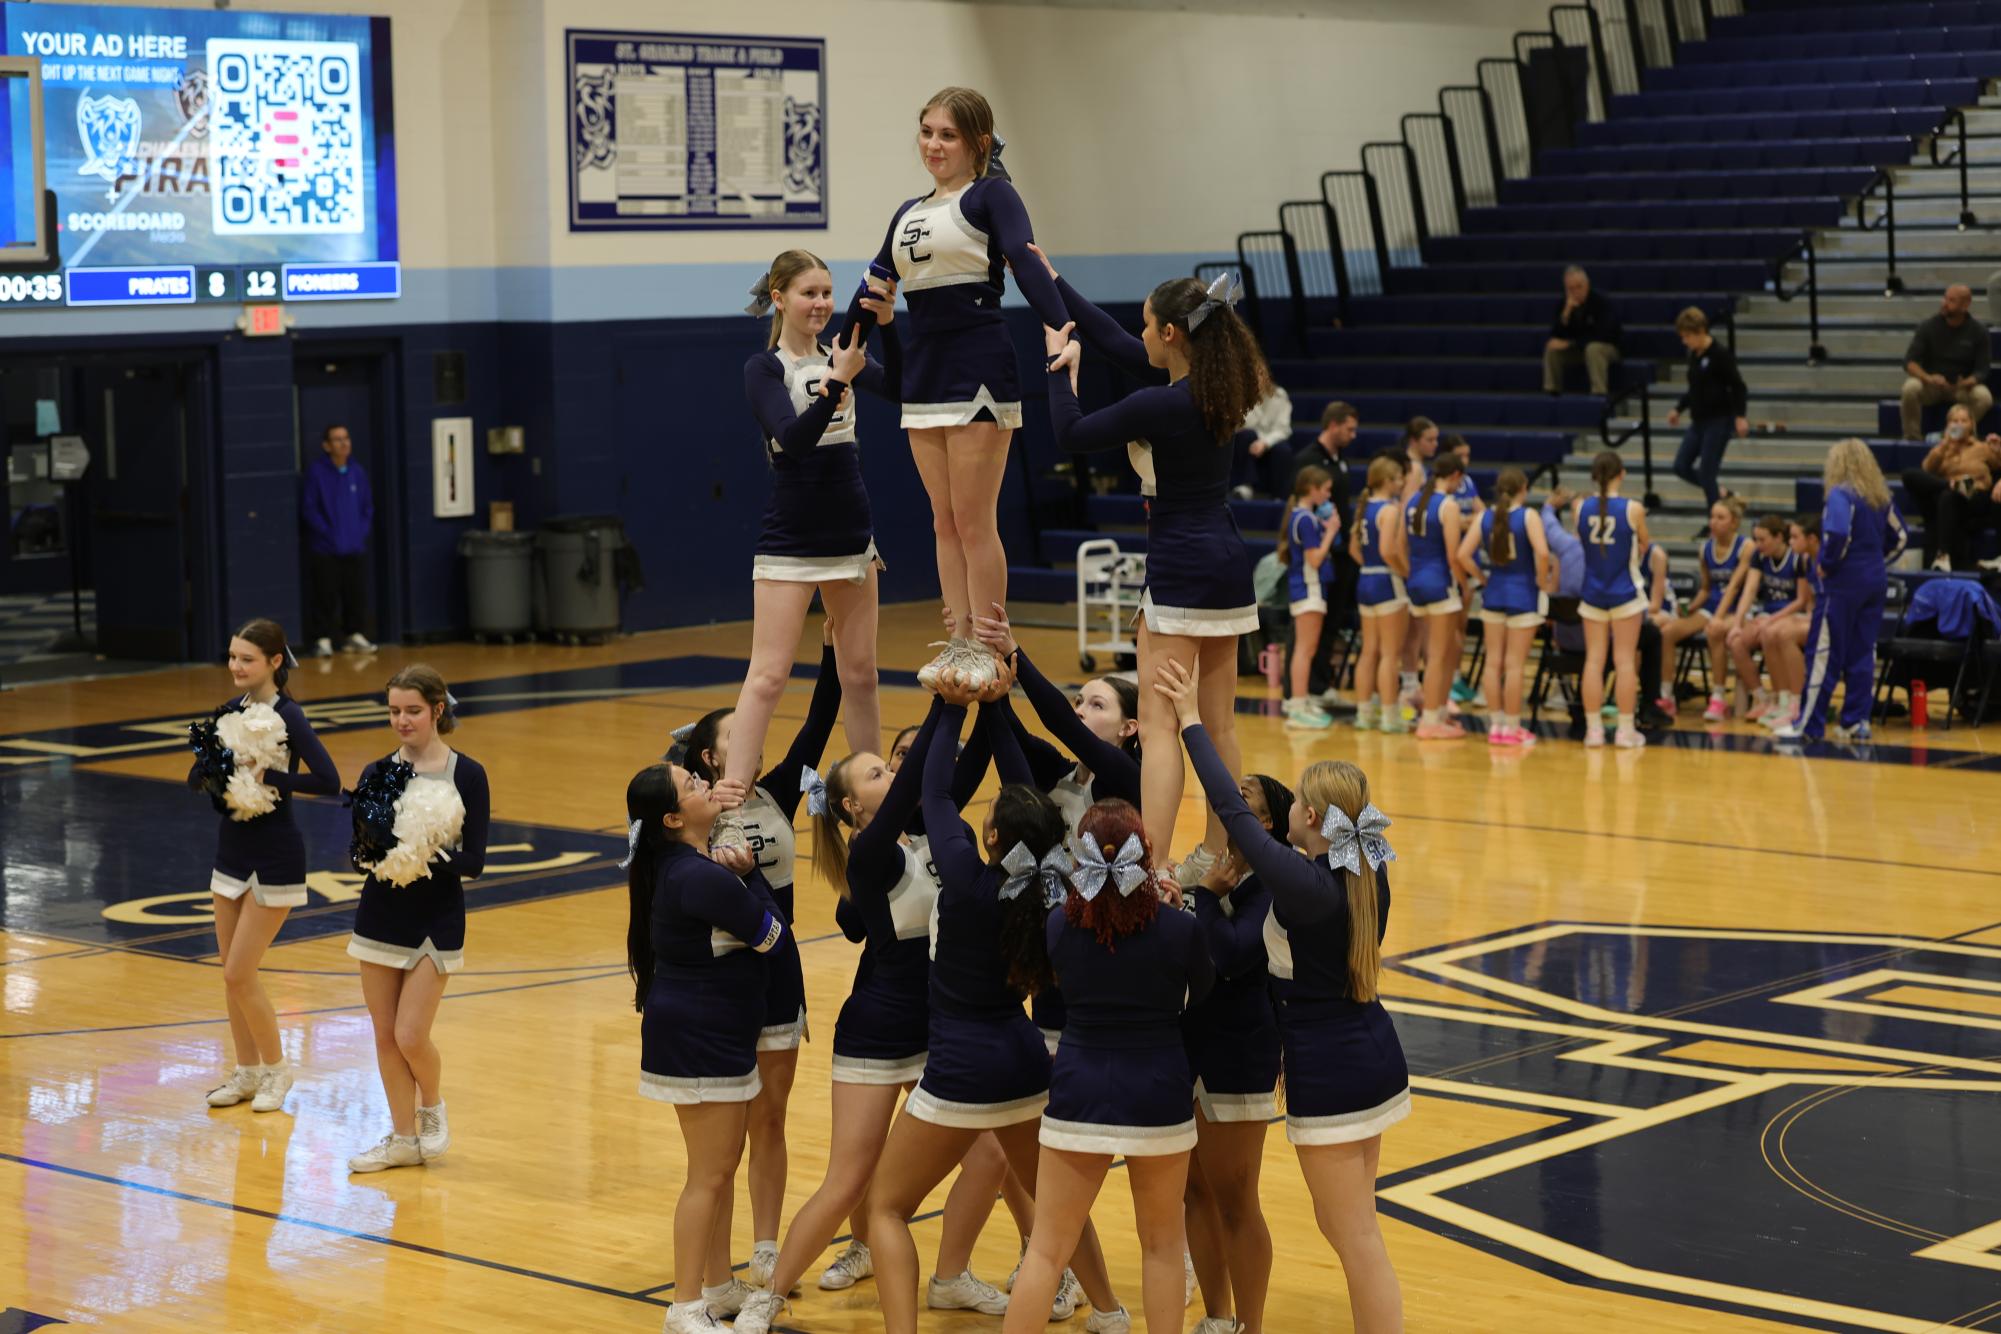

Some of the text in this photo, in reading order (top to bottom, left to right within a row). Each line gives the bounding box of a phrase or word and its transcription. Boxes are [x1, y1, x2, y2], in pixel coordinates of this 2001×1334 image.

[21, 31, 188, 59] YOUR AD HERE
[41, 63, 61, 81] GHT
[62, 64, 77, 81] UP
[77, 64, 97, 82] THE
[97, 65, 122, 82] NEXT
[115, 156, 210, 193] PIRA
[68, 212, 186, 232] SCOREBOARD
[0, 275, 62, 301] 00:35
[128, 276, 189, 296] PIRATES
[208, 271, 226, 297] 8
[246, 271, 277, 297] 12
[287, 272, 360, 292] PIONEERS
[253, 306, 279, 332] EXIT
[1587, 515, 1617, 545] 22
